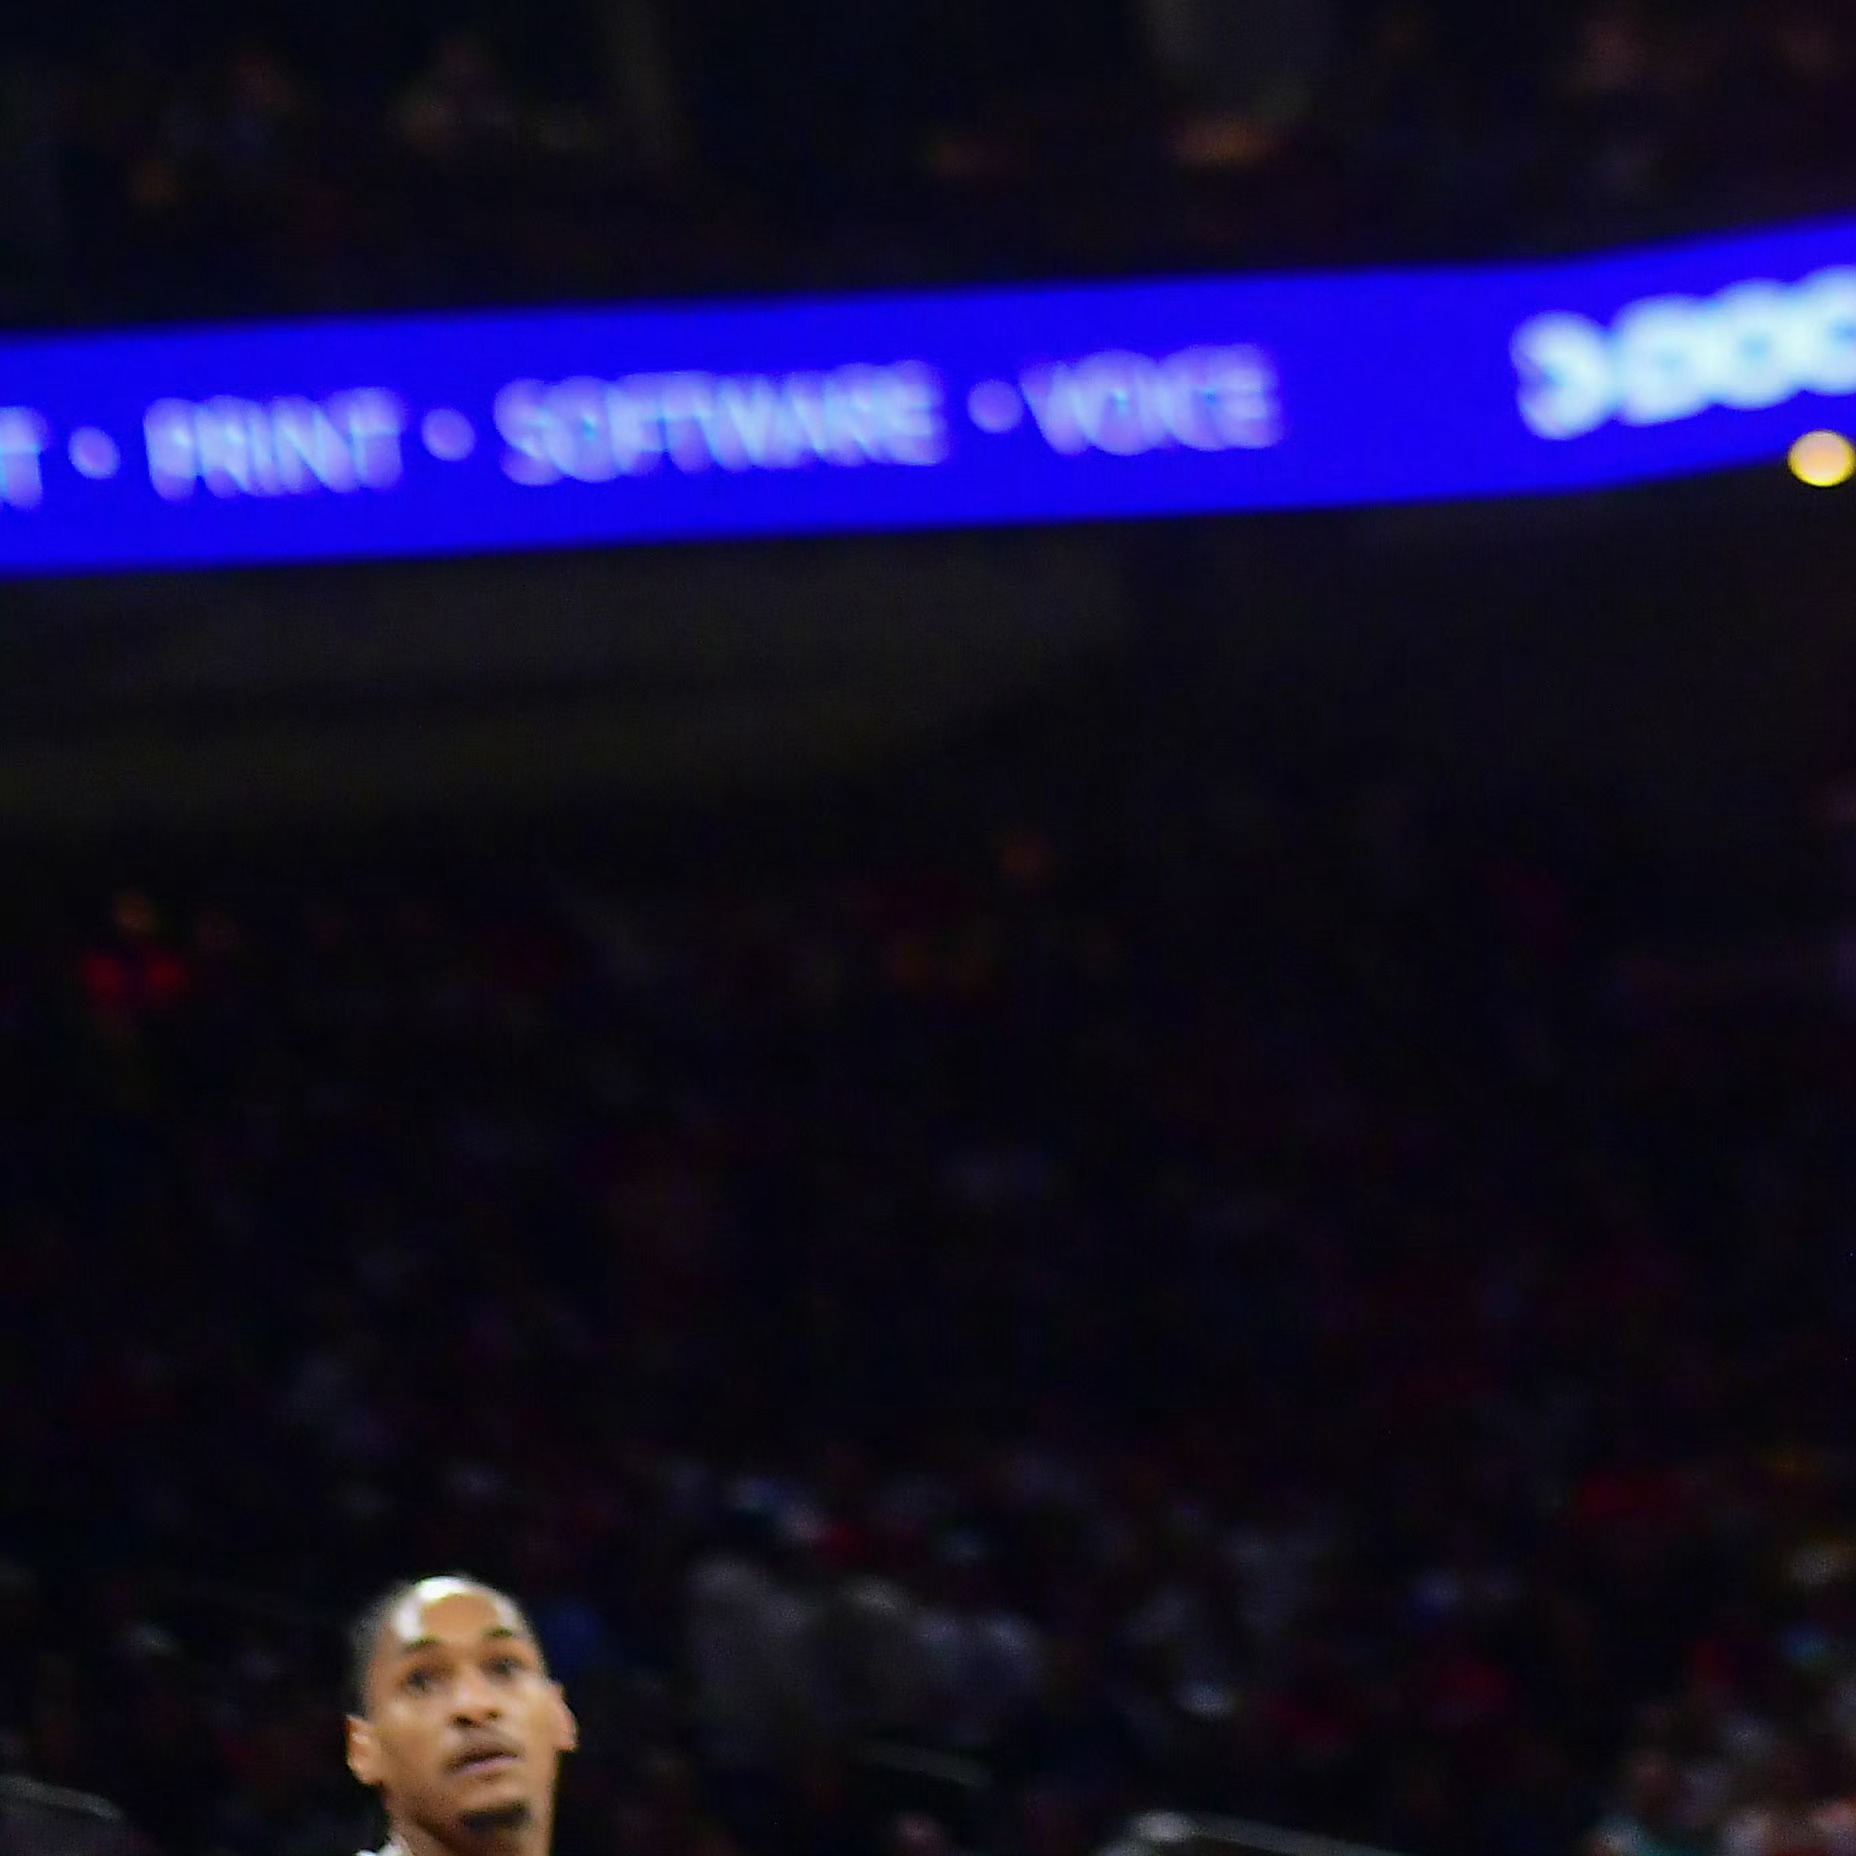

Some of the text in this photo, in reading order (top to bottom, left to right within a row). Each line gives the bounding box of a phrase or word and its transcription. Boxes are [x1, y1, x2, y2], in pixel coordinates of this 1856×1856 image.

[144, 387, 404, 498] PRINT
[494, 360, 946, 486] SOFTWARE
[1020, 344, 1281, 456] VOICE
